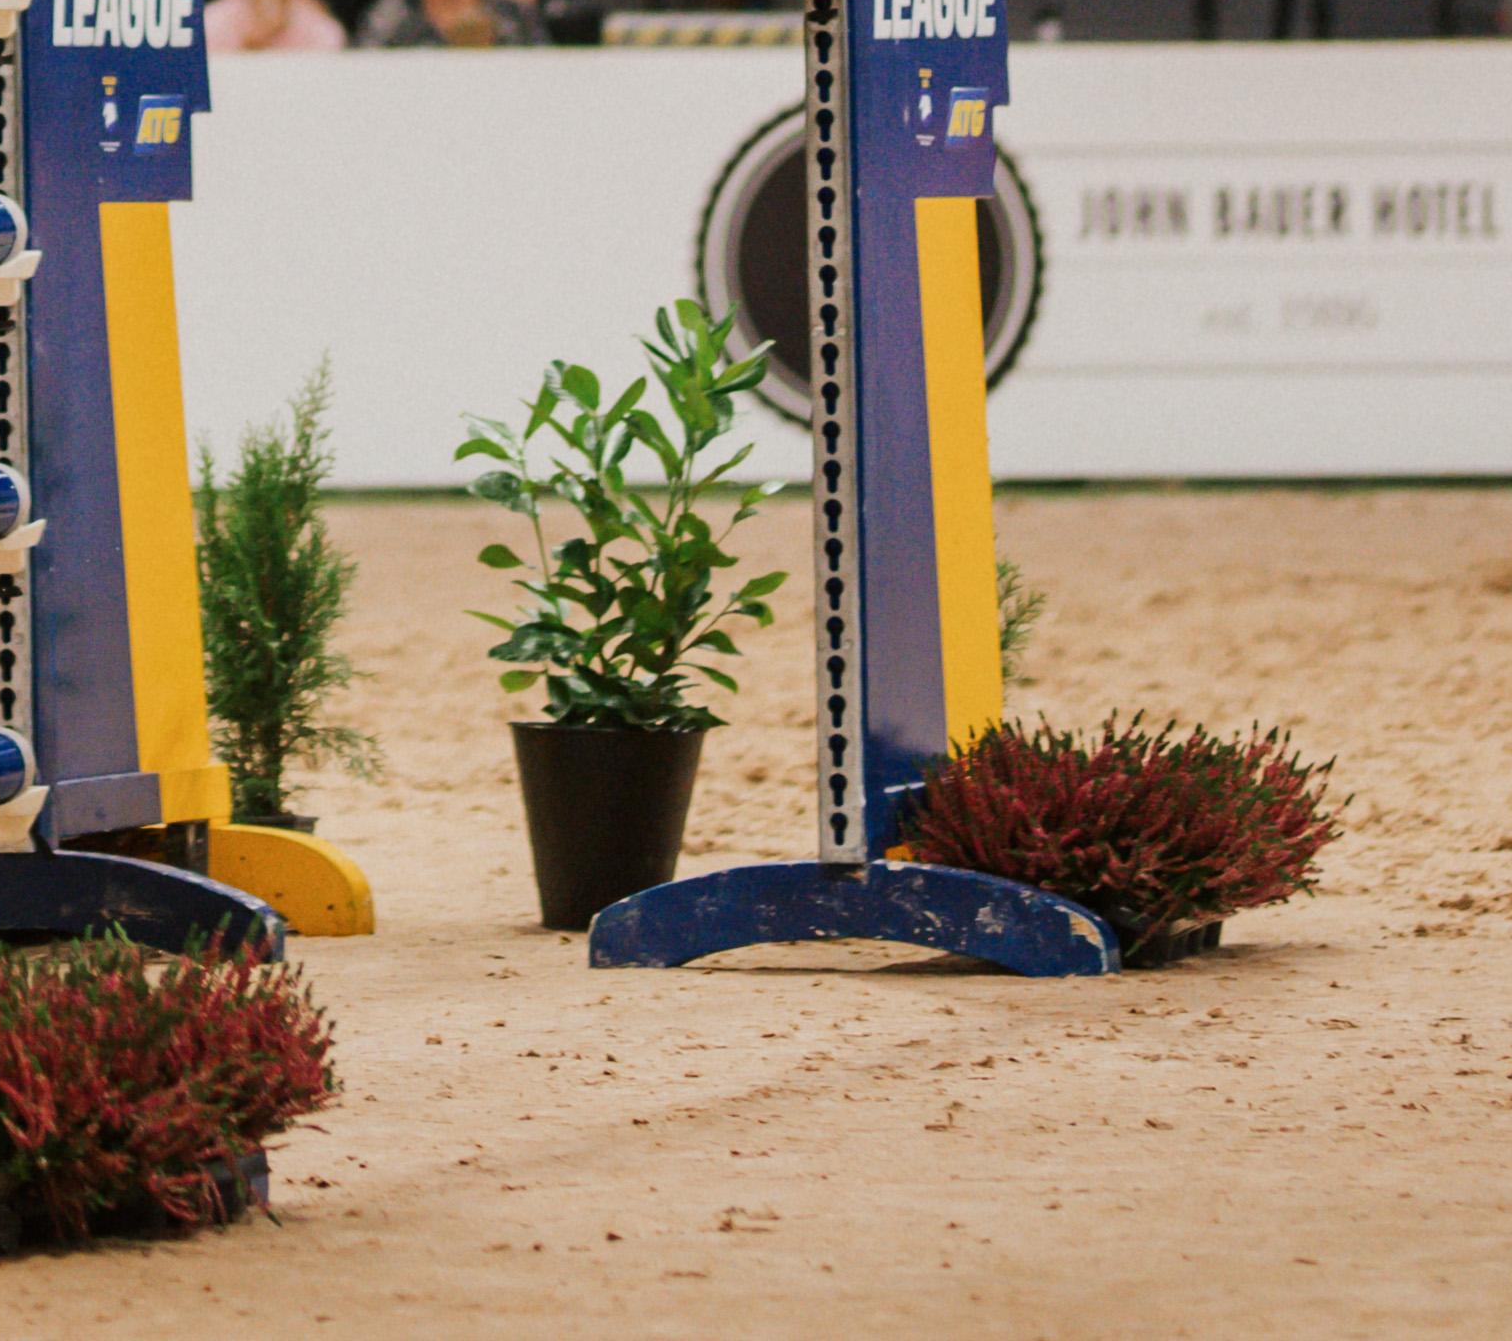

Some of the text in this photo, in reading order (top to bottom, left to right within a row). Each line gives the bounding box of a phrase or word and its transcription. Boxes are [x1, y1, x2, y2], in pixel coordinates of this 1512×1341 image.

[136, 106, 183, 145] ATG
[946, 99, 987, 138] ATG
[1078, 182, 1499, 240] JOHN BAUER HOTEL
